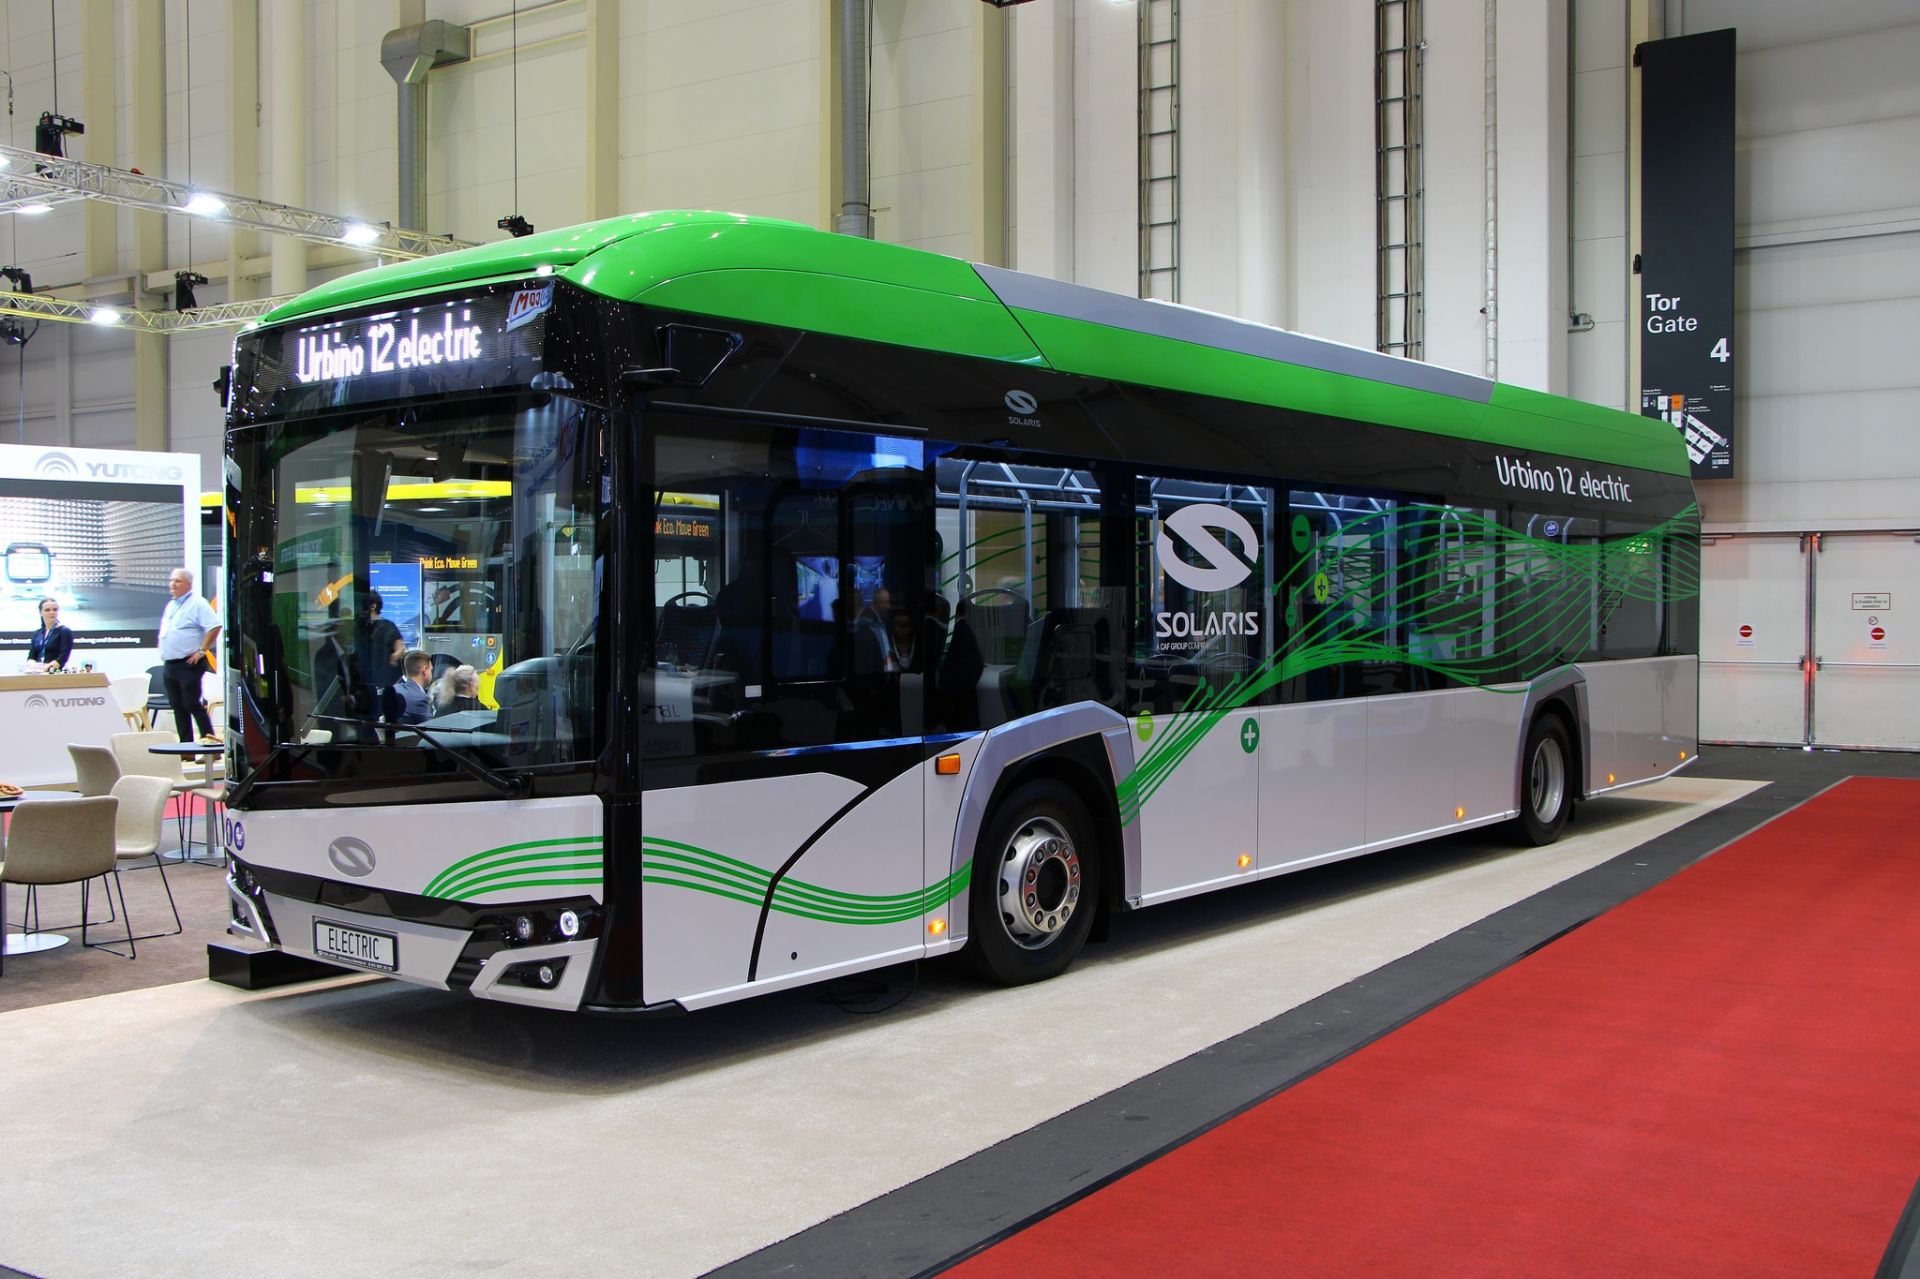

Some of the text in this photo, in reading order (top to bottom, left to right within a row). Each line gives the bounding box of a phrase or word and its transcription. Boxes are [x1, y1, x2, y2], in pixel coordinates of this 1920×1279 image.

[1646, 294, 1680, 312] Tor
[1647, 315, 1698, 333] Gate
[298, 309, 482, 383] Urbino 12 electric
[1710, 338, 1730, 363] 4
[1008, 416, 1041, 428] SOLARIS
[85, 462, 183, 480] YUTONG
[1495, 455, 1632, 502] Urbino 12 electric
[1156, 611, 1259, 637] SOLARIS
[1160, 642, 1170, 651] CAF
[1171, 642, 1188, 650] GROUP
[52, 697, 105, 708] YUTONG
[328, 928, 379, 960] ELECTRIC
